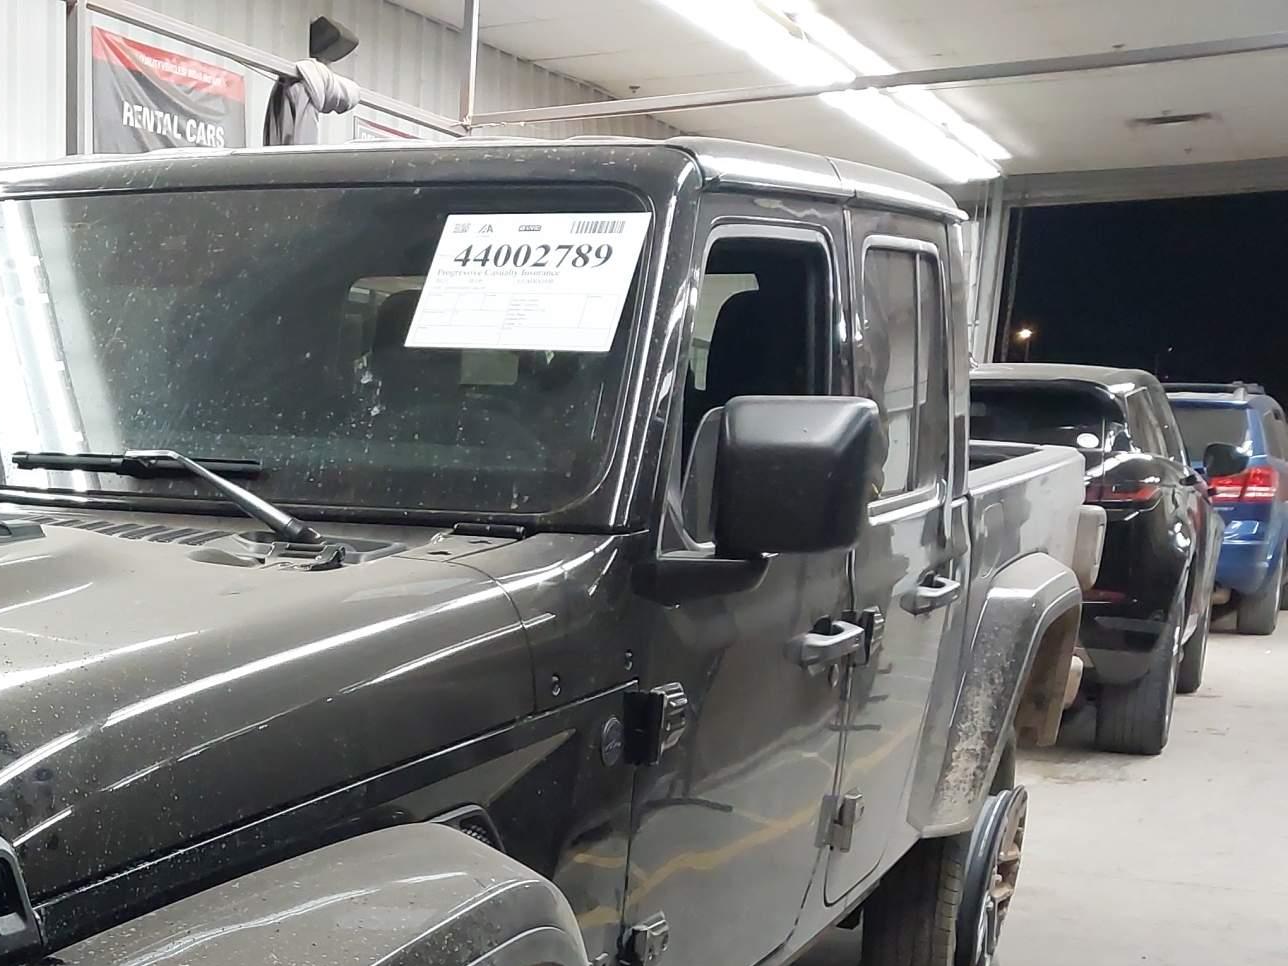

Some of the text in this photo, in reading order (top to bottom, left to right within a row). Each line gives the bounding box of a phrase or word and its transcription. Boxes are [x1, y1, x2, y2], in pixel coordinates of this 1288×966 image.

[122, 101, 225, 148] RENTAL CARS
[454, 244, 613, 268] 44002789
